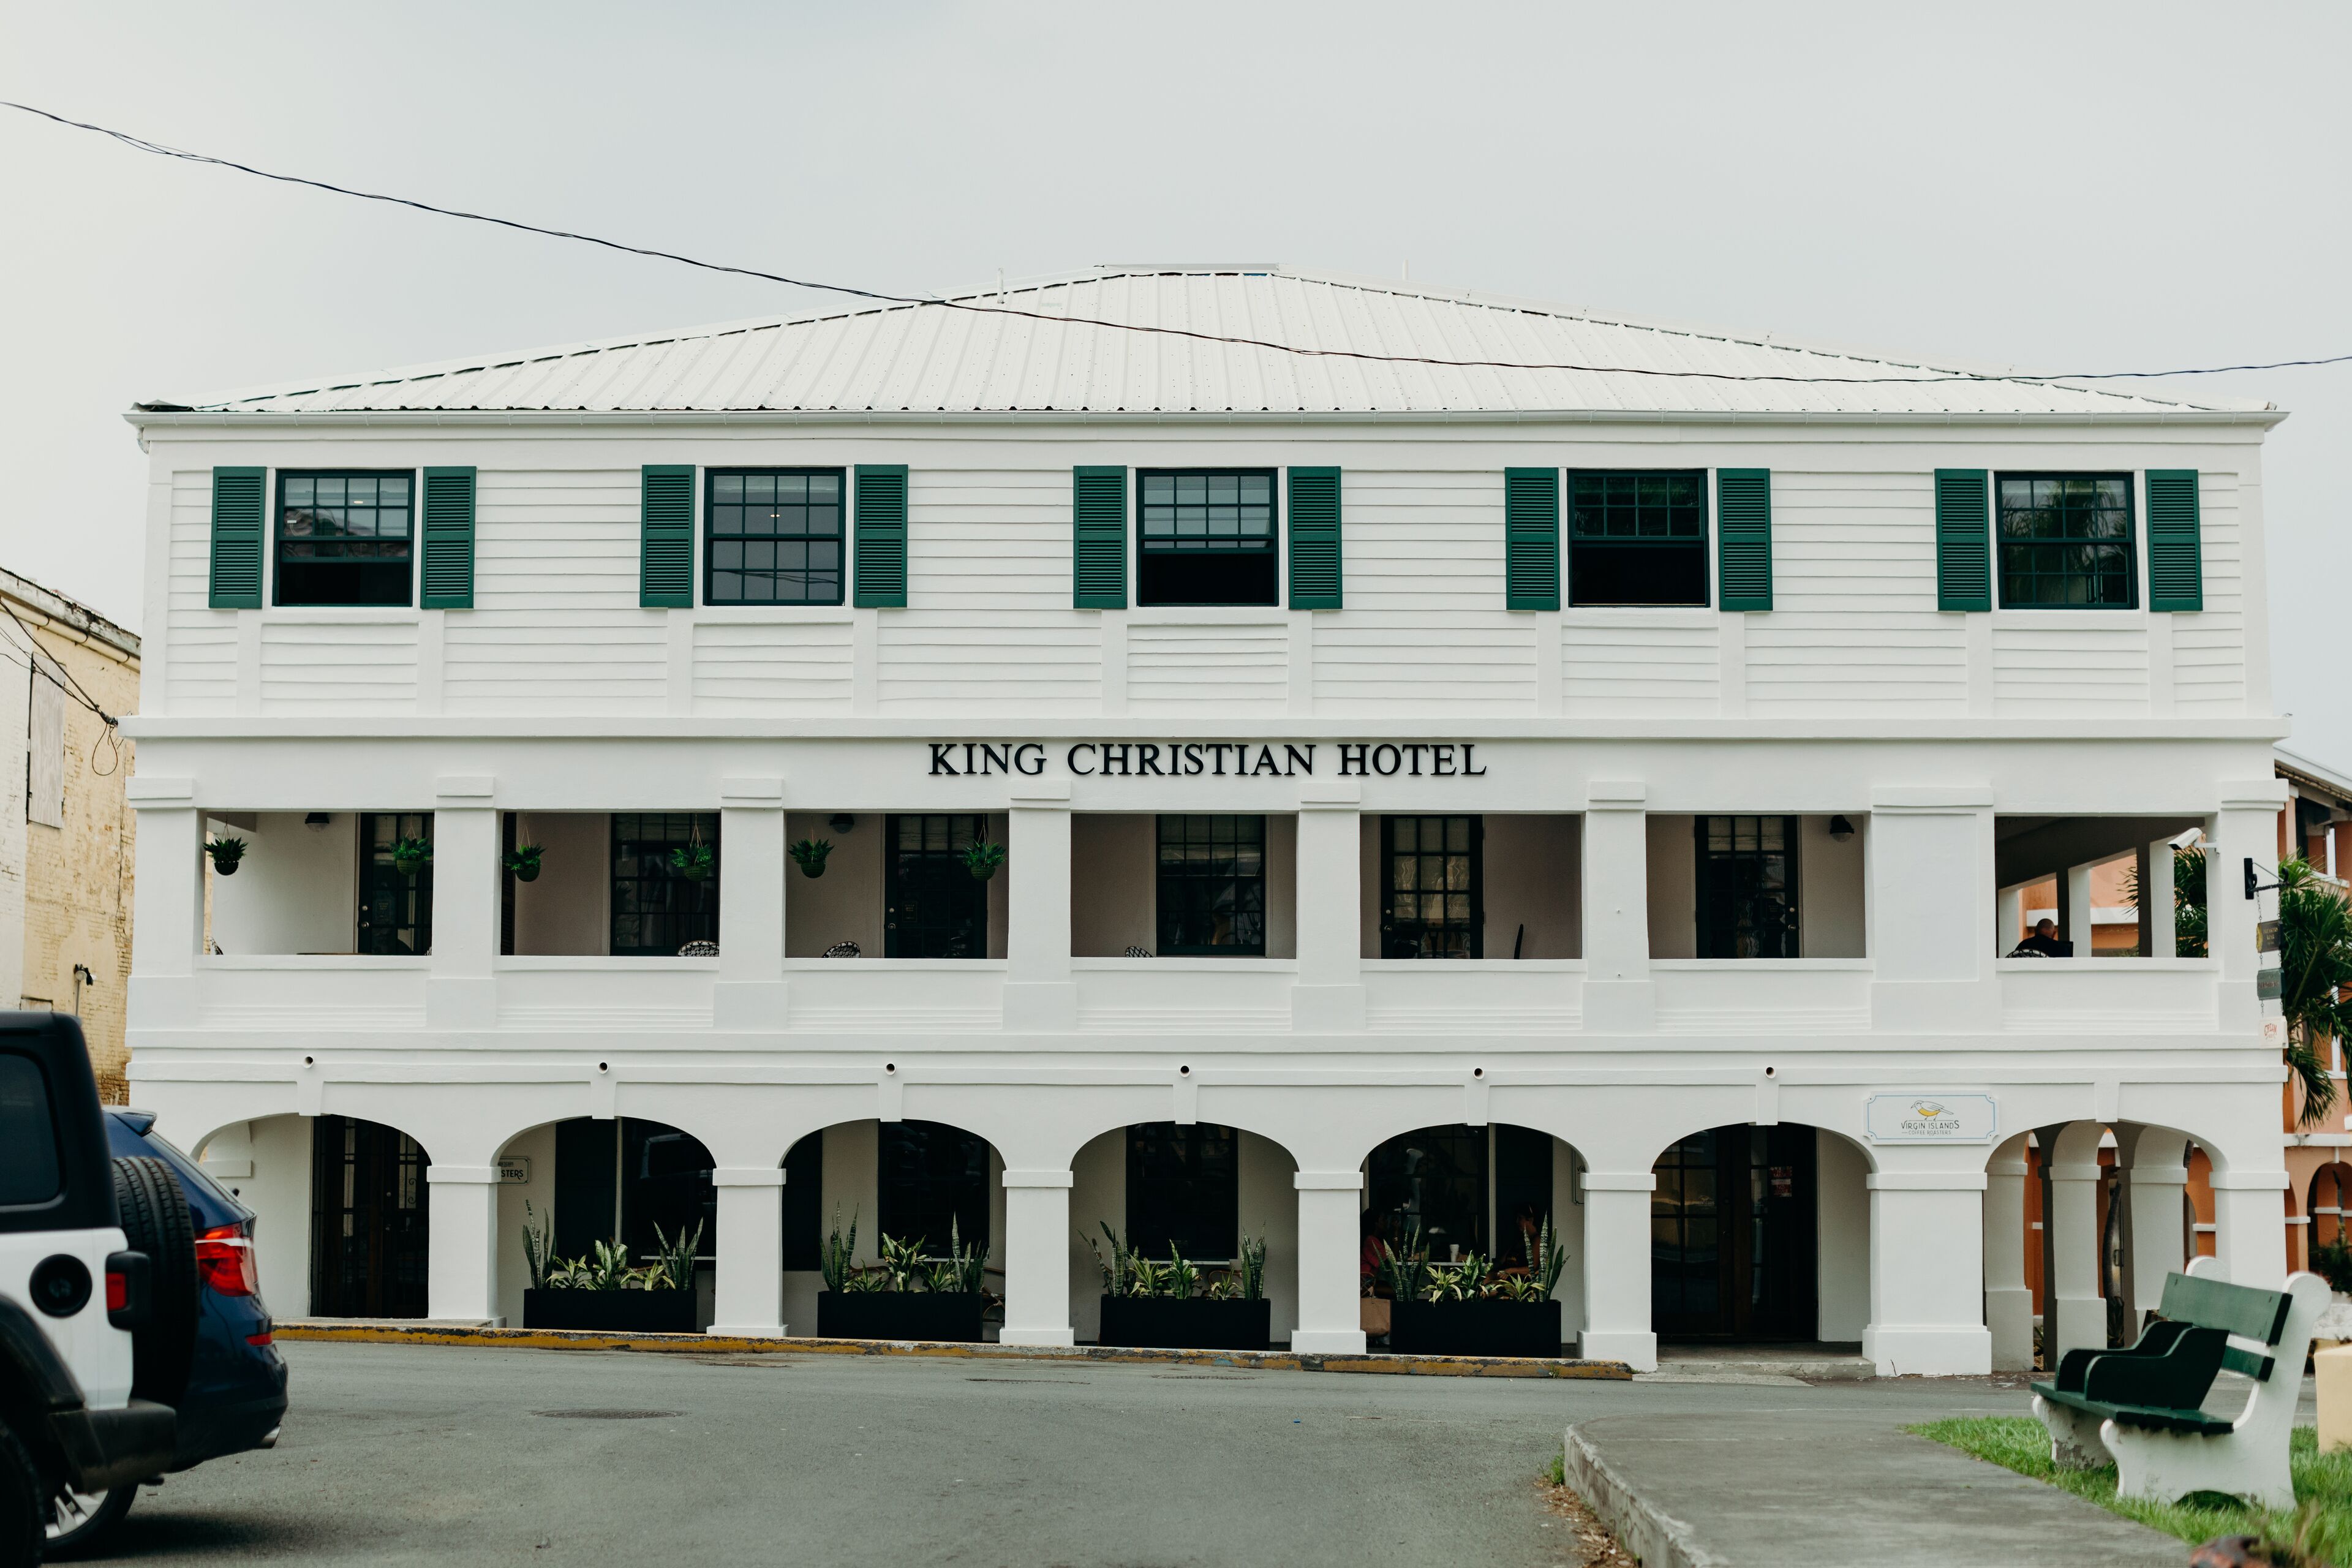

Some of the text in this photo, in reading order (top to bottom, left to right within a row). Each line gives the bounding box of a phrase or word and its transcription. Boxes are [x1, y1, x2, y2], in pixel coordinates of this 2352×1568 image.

[928, 743, 1487, 775] KING CHRISTIAN HOTEL
[1901, 1120, 1959, 1131] VIRGIN ISLANDS
